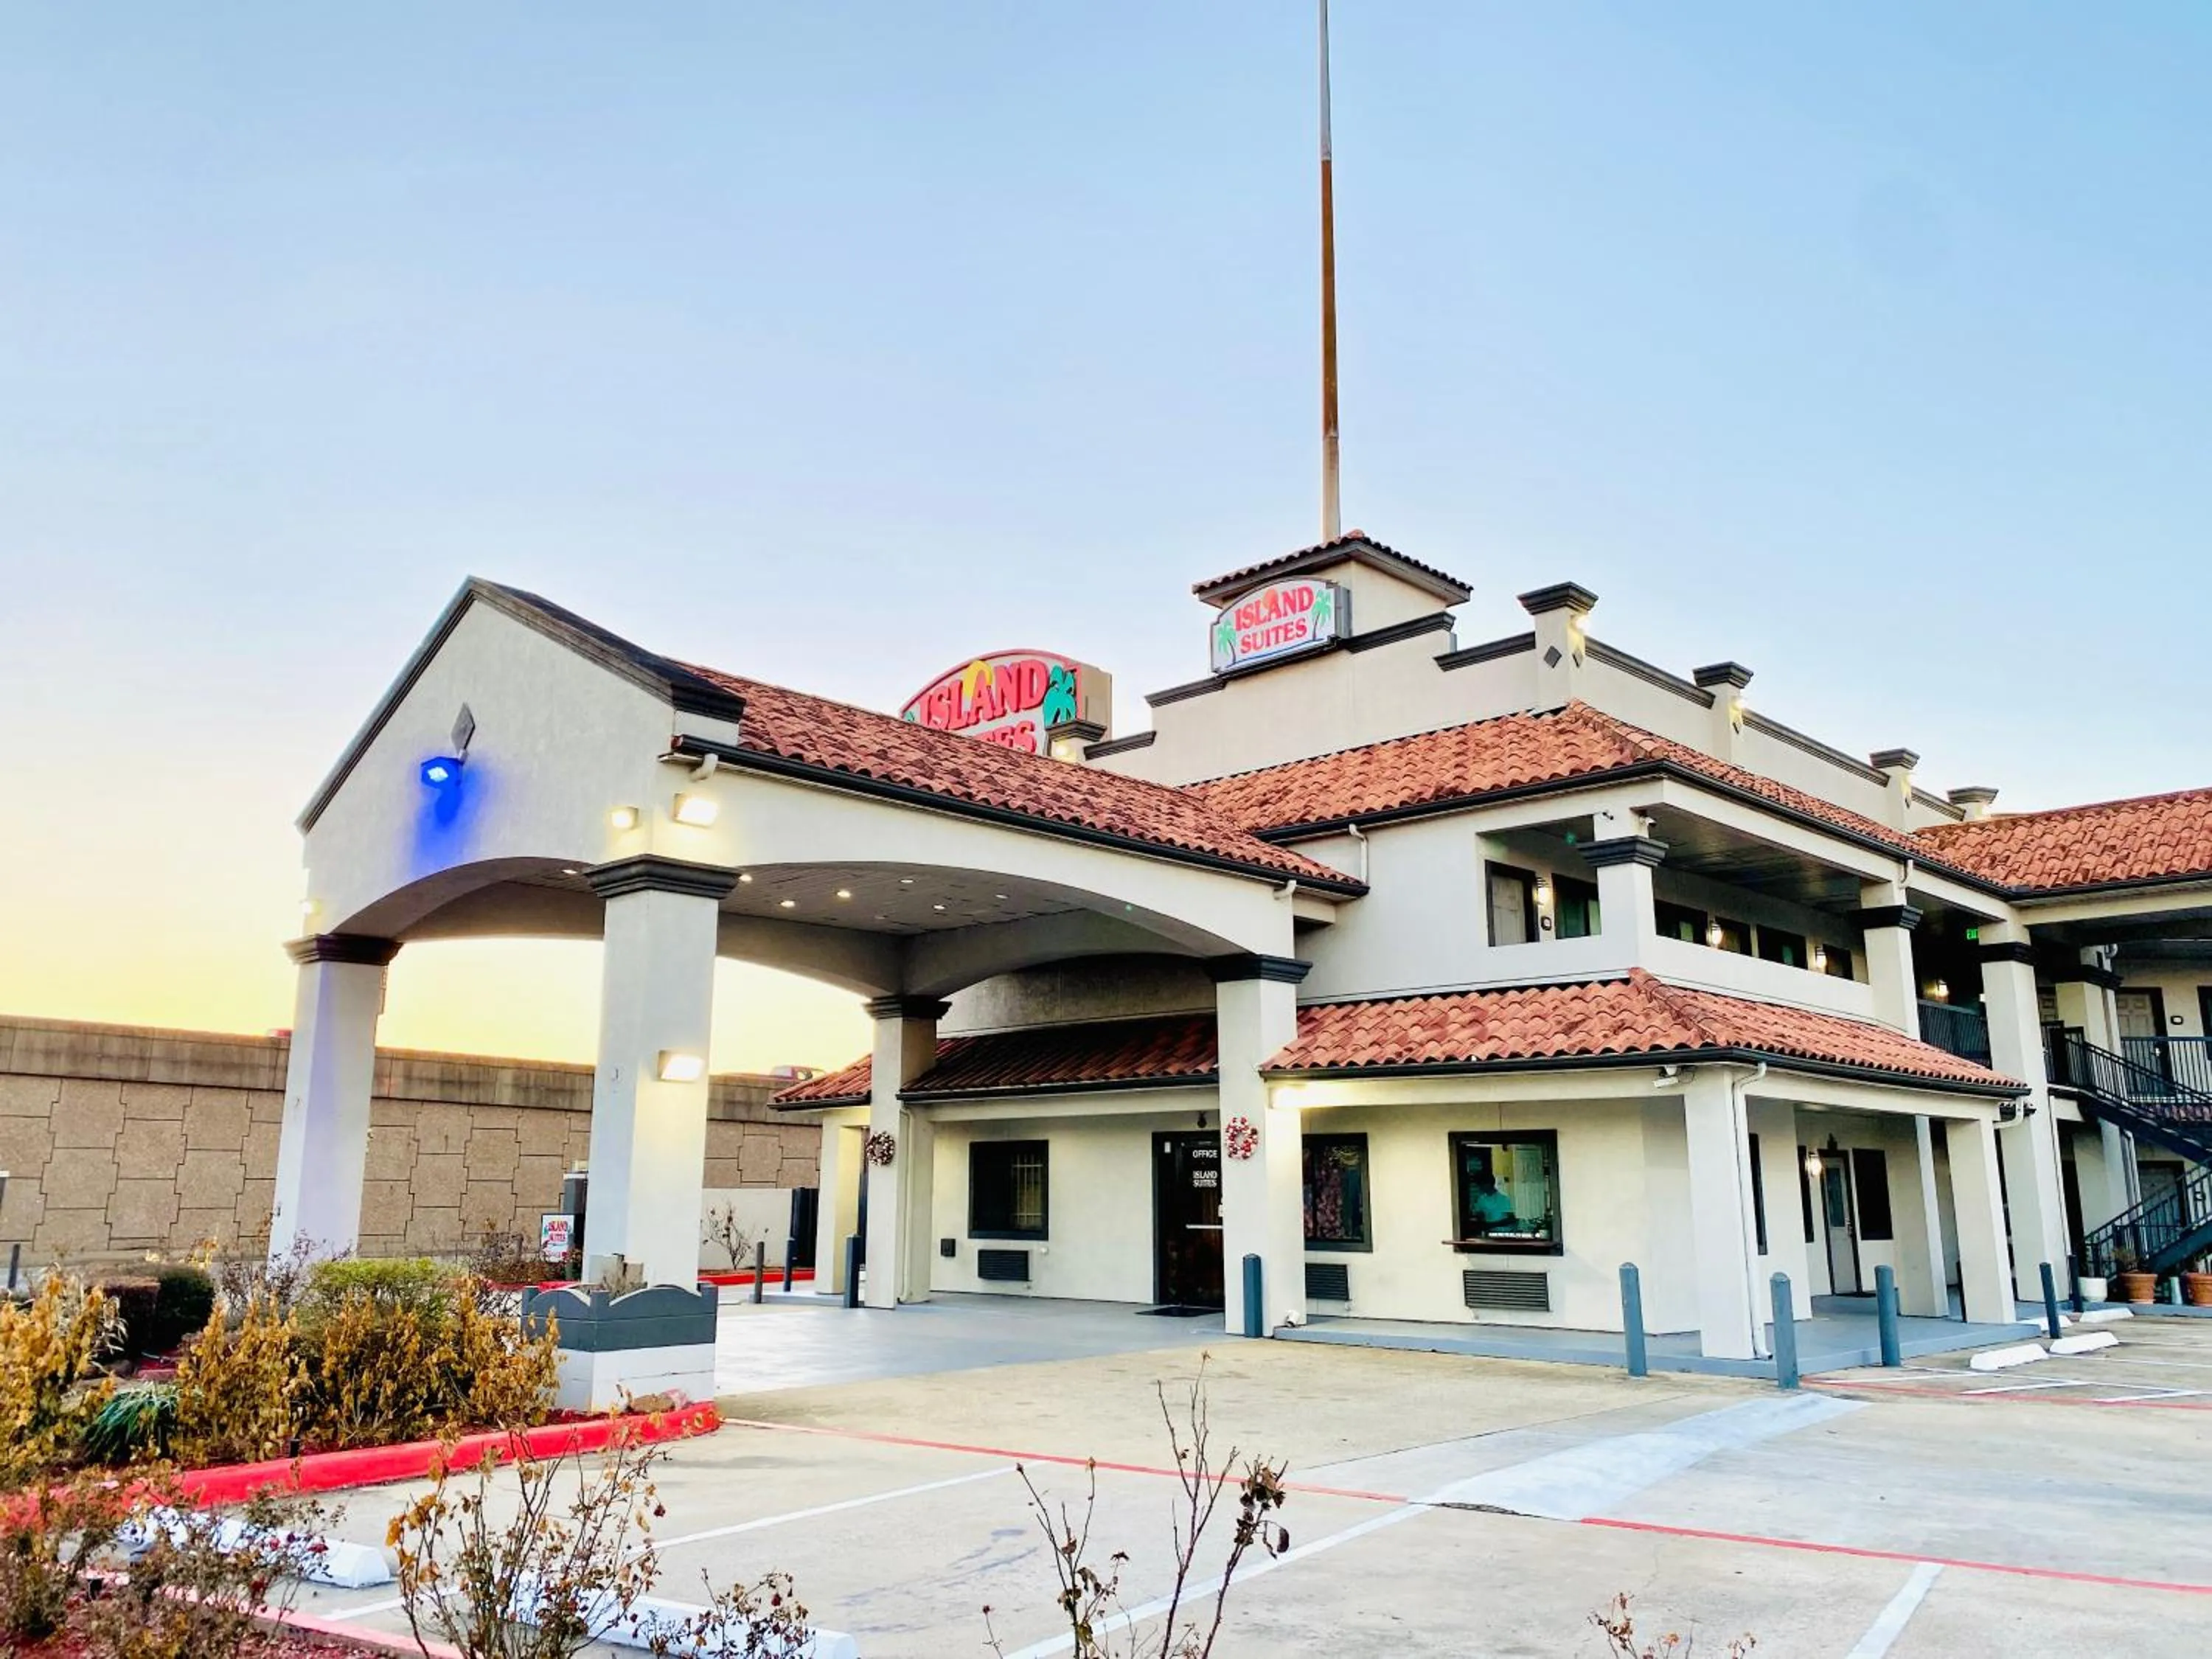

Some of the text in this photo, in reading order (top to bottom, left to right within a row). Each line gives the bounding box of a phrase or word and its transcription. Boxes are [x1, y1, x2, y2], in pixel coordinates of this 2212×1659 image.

[1234, 585, 1314, 631] ISLAND
[1240, 618, 1307, 654] SUITES
[919, 659, 1049, 730] ISLAND
[1192, 1150, 1218, 1158] OFFICE
[1192, 1170, 1218, 1179] ISLAND
[1192, 1179, 1217, 1188] SUITES
